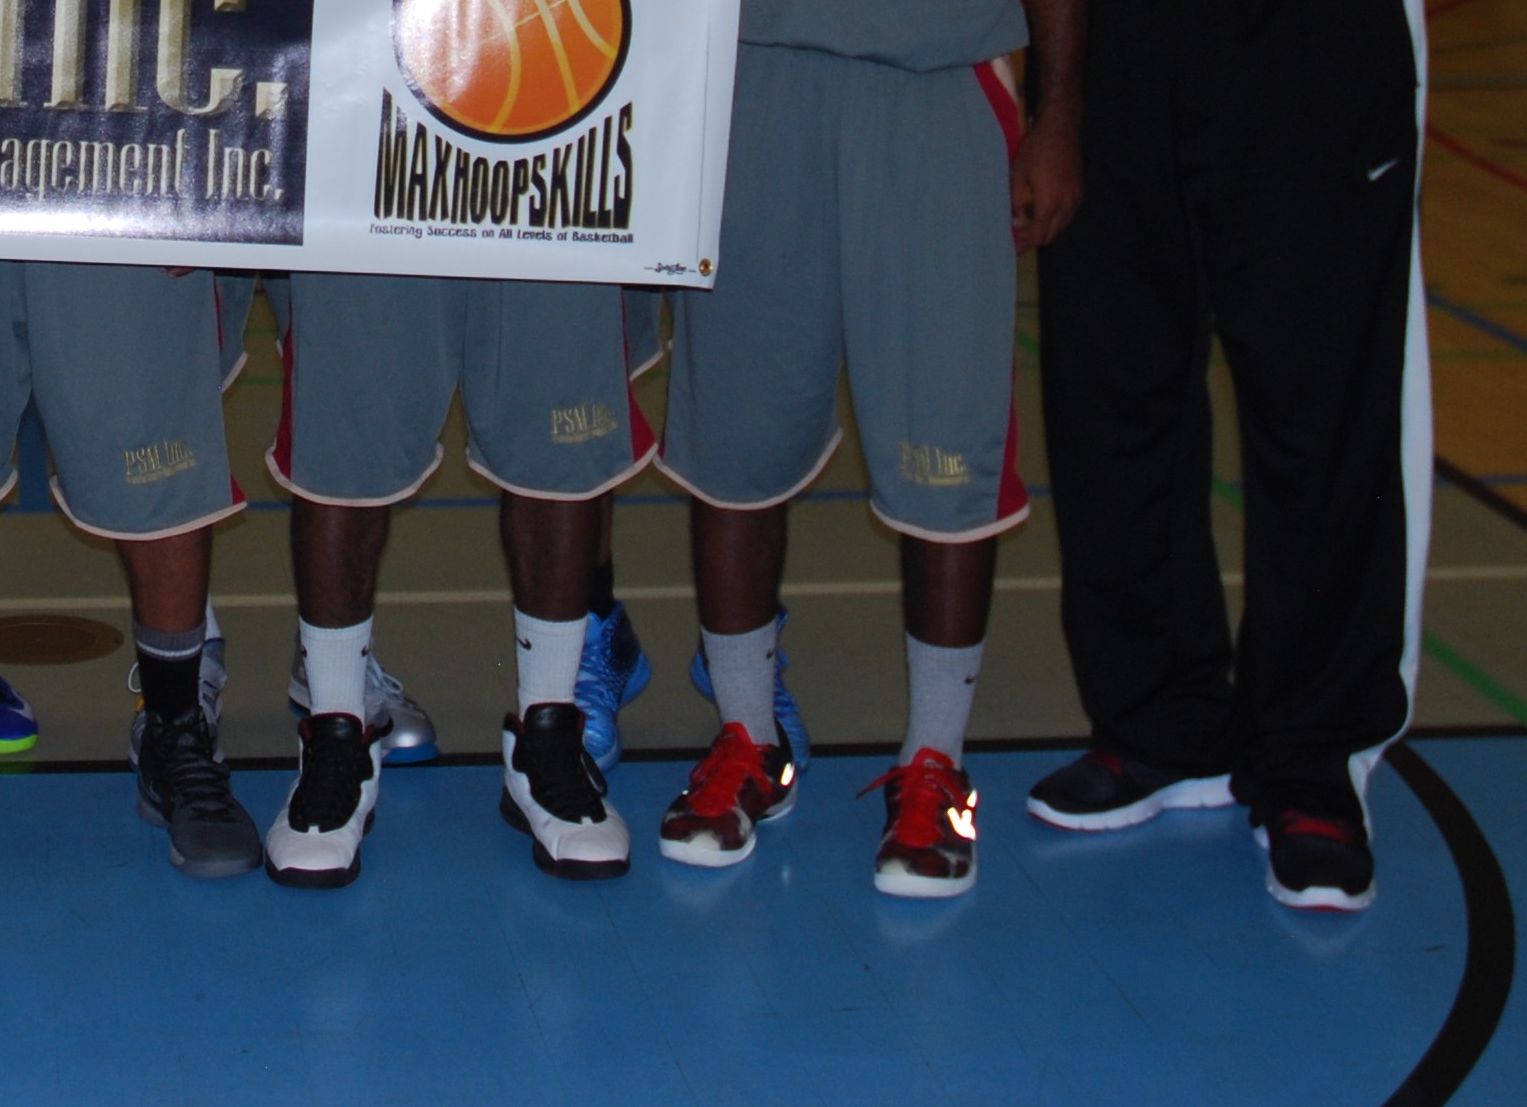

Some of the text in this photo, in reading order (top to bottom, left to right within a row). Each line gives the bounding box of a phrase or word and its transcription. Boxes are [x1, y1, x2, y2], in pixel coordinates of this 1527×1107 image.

[205, 128, 285, 200] Inc.
[374, 86, 634, 230] MAXHOOPSKILLS
[426, 224, 477, 238] Success
[482, 228, 495, 239] on
[498, 228, 513, 239] All
[572, 230, 634, 244] Basketball
[124, 445, 162, 476] PSM
